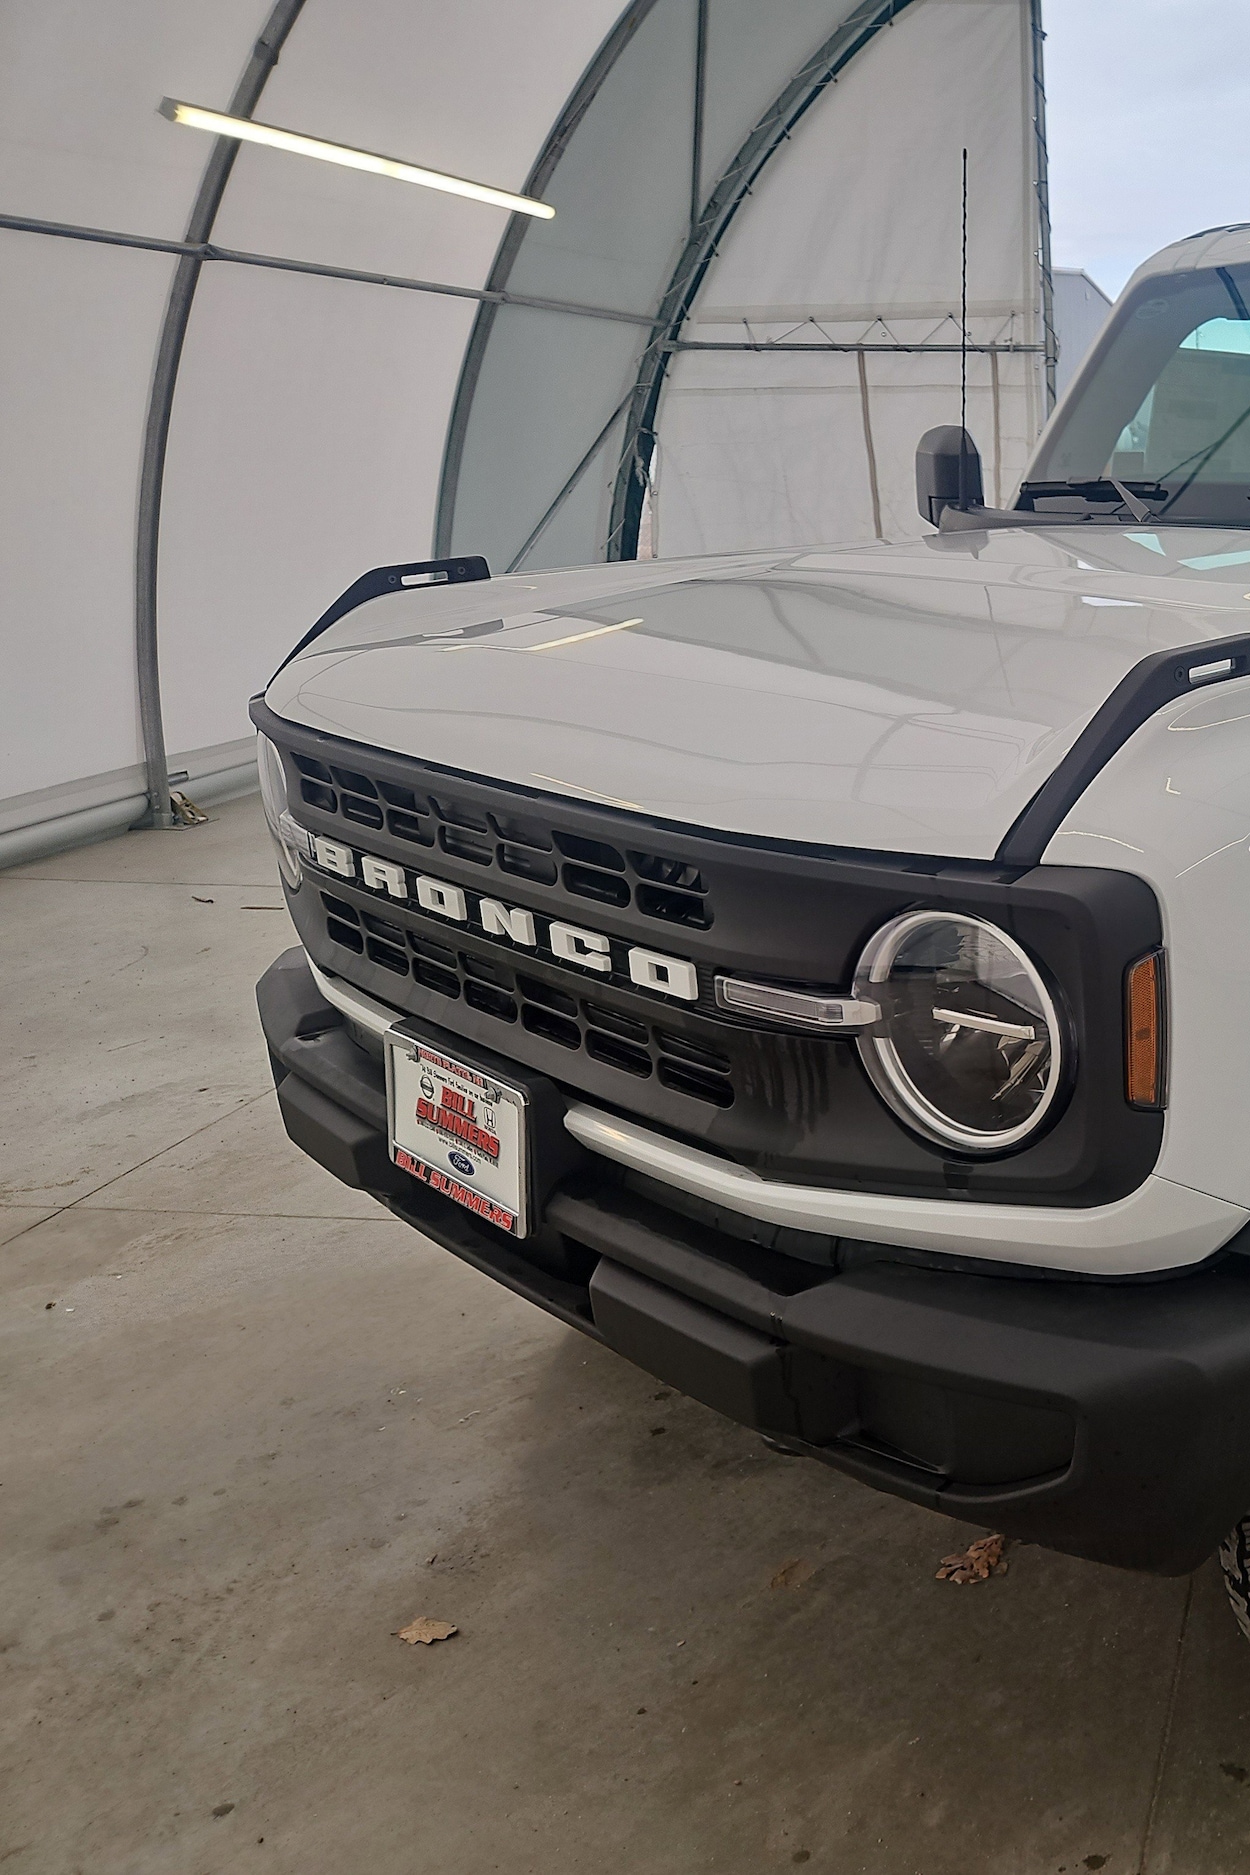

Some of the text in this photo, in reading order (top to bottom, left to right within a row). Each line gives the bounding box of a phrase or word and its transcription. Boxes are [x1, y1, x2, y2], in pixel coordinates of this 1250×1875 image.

[315, 834, 699, 1001] BRONCO
[416, 1097, 500, 1159] SUMMERS
[440, 1085, 477, 1122] BILL
[395, 1149, 514, 1231] BILL SUMMERS
[452, 1153, 471, 1173] Ford
